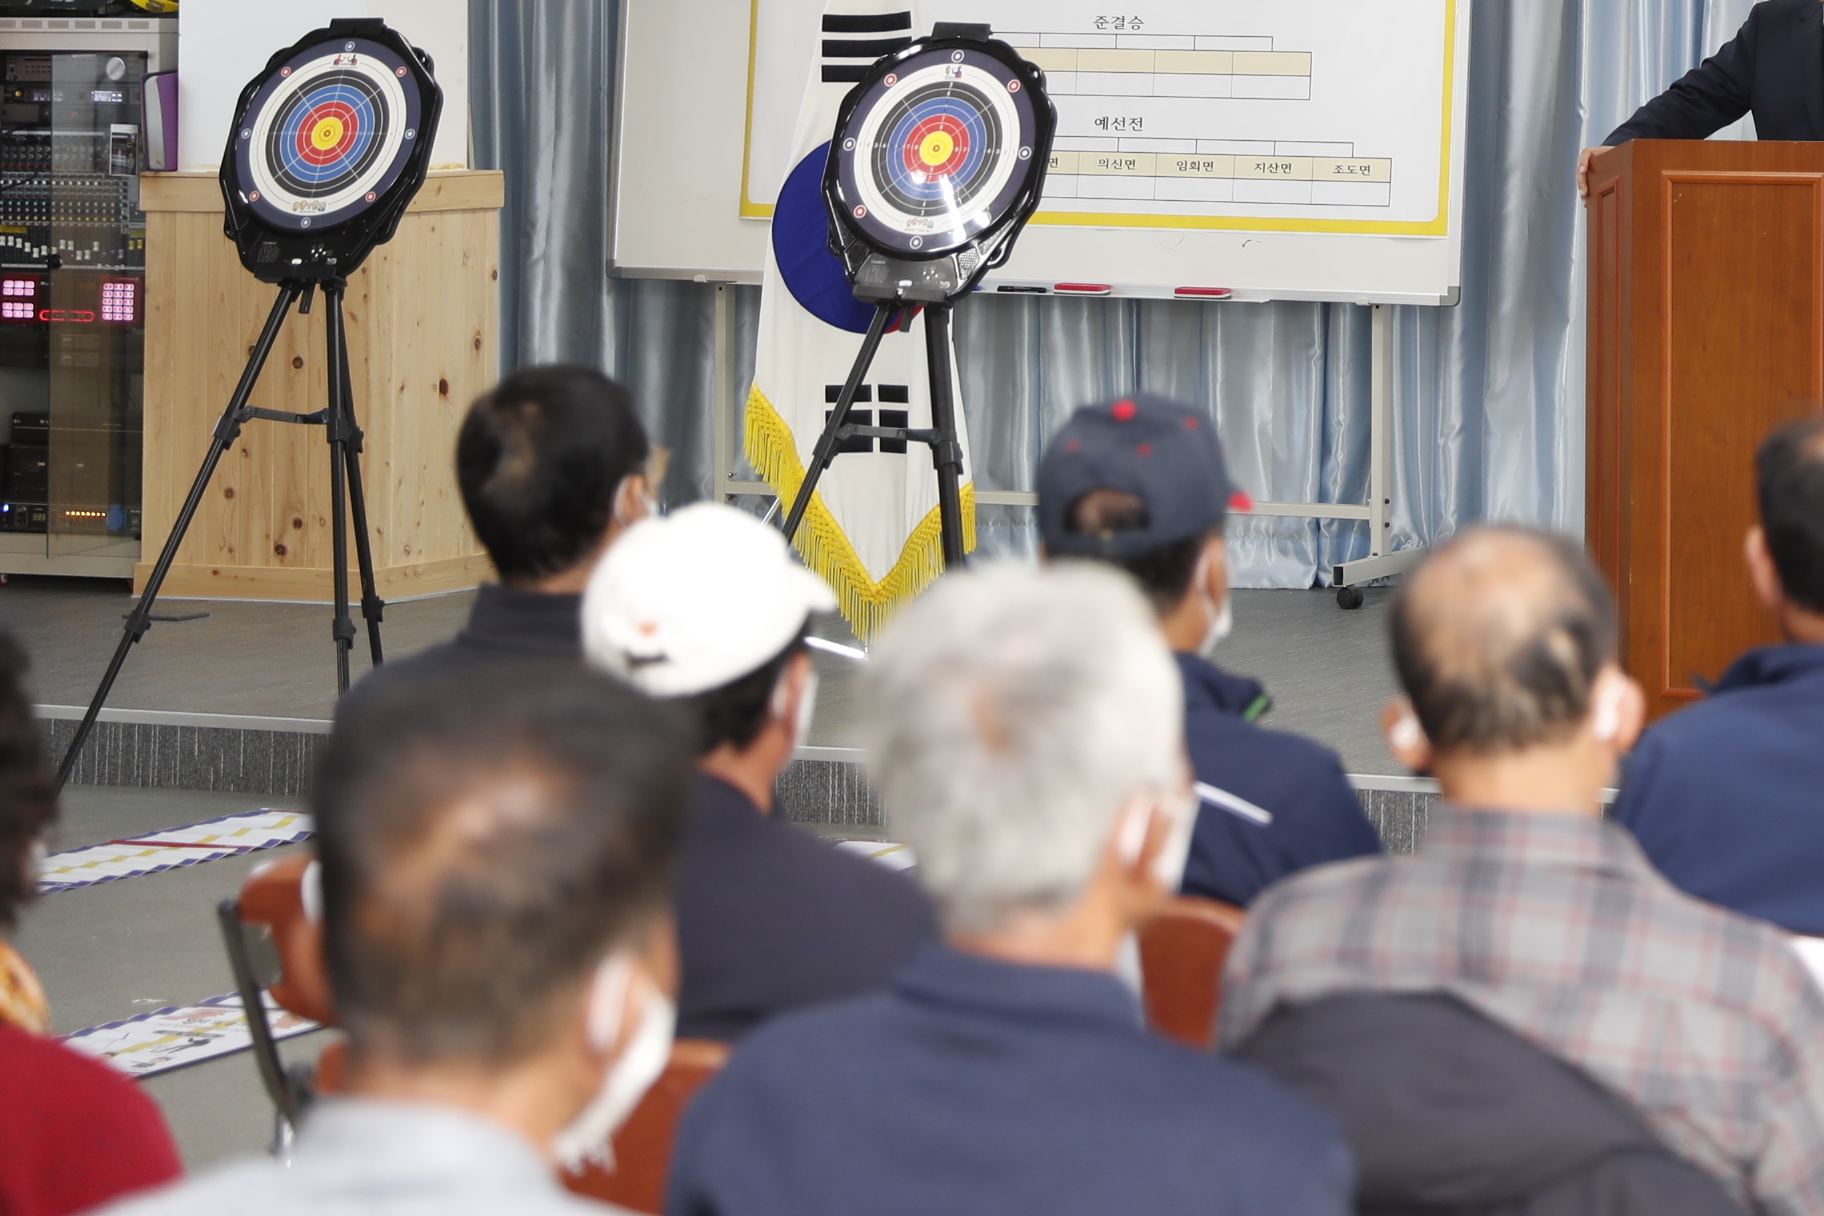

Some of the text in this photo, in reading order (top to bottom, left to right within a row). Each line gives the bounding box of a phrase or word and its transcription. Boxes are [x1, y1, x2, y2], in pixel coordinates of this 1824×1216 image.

[1093, 15, 1145, 31] 준결승
[1094, 115, 1144, 132] 예선전
[1098, 158, 1137, 170] 의신면
[1176, 160, 1215, 173] 임회면
[1254, 162, 1293, 175] 지산면
[1332, 164, 1372, 176] 조도면
